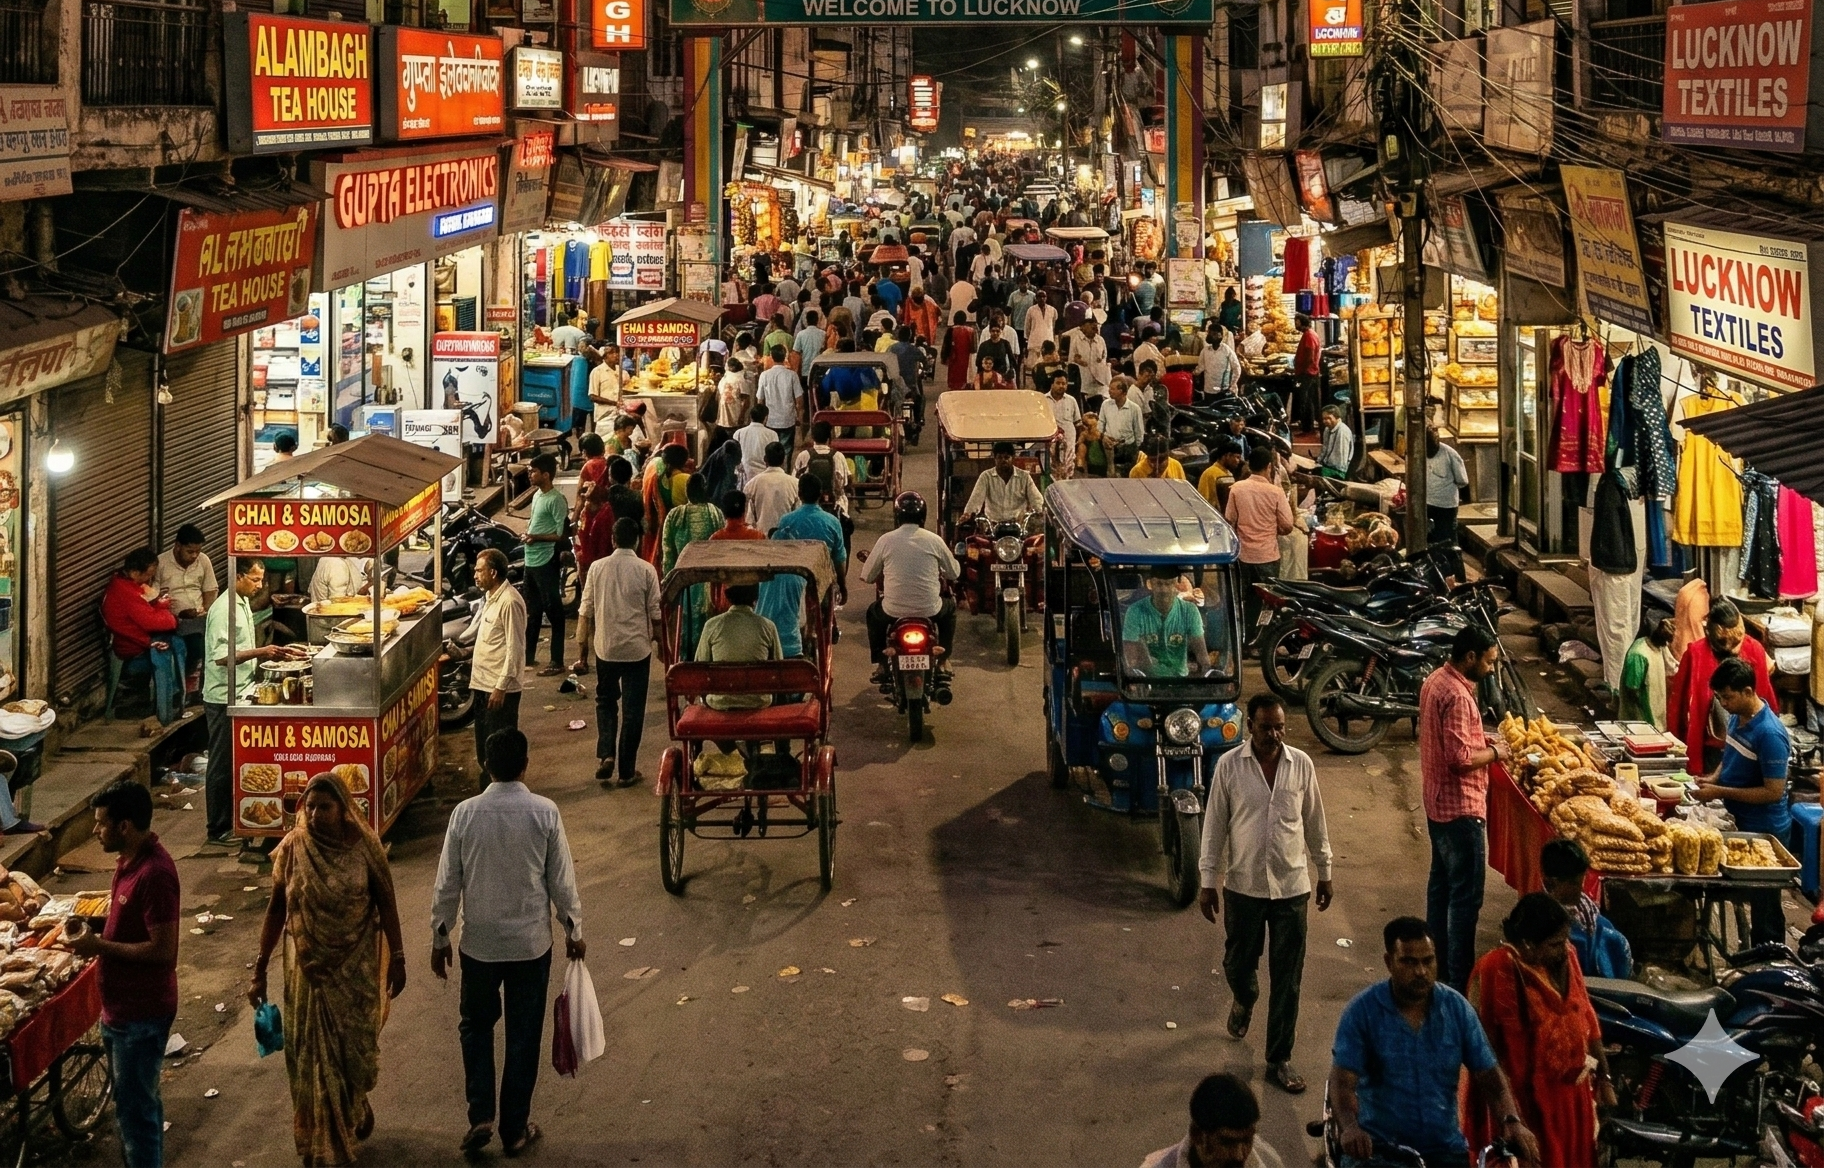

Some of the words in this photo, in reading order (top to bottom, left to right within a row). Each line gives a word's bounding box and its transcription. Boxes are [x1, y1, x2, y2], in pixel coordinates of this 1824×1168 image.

[255, 25, 368, 80] ALAMBAGH
[1672, 19, 1803, 70] LUCKNOW
[270, 86, 303, 122] TEA
[306, 86, 357, 121] HOUSE
[1677, 76, 1789, 118] TEXTILES
[339, 169, 401, 229] GUPTA
[405, 156, 497, 214] ELECTRONICS
[211, 281, 238, 313] TEA
[241, 271, 286, 306] HOUSE
[1670, 247, 1802, 321] LUCKNOW
[1690, 304, 1784, 359] TEXTILES
[234, 504, 276, 526] CHAI
[281, 504, 294, 526] &
[299, 503, 372, 526] SAMOSA
[239, 725, 279, 748] CHAI
[284, 725, 296, 748] &
[301, 725, 371, 749] SAMOSA
